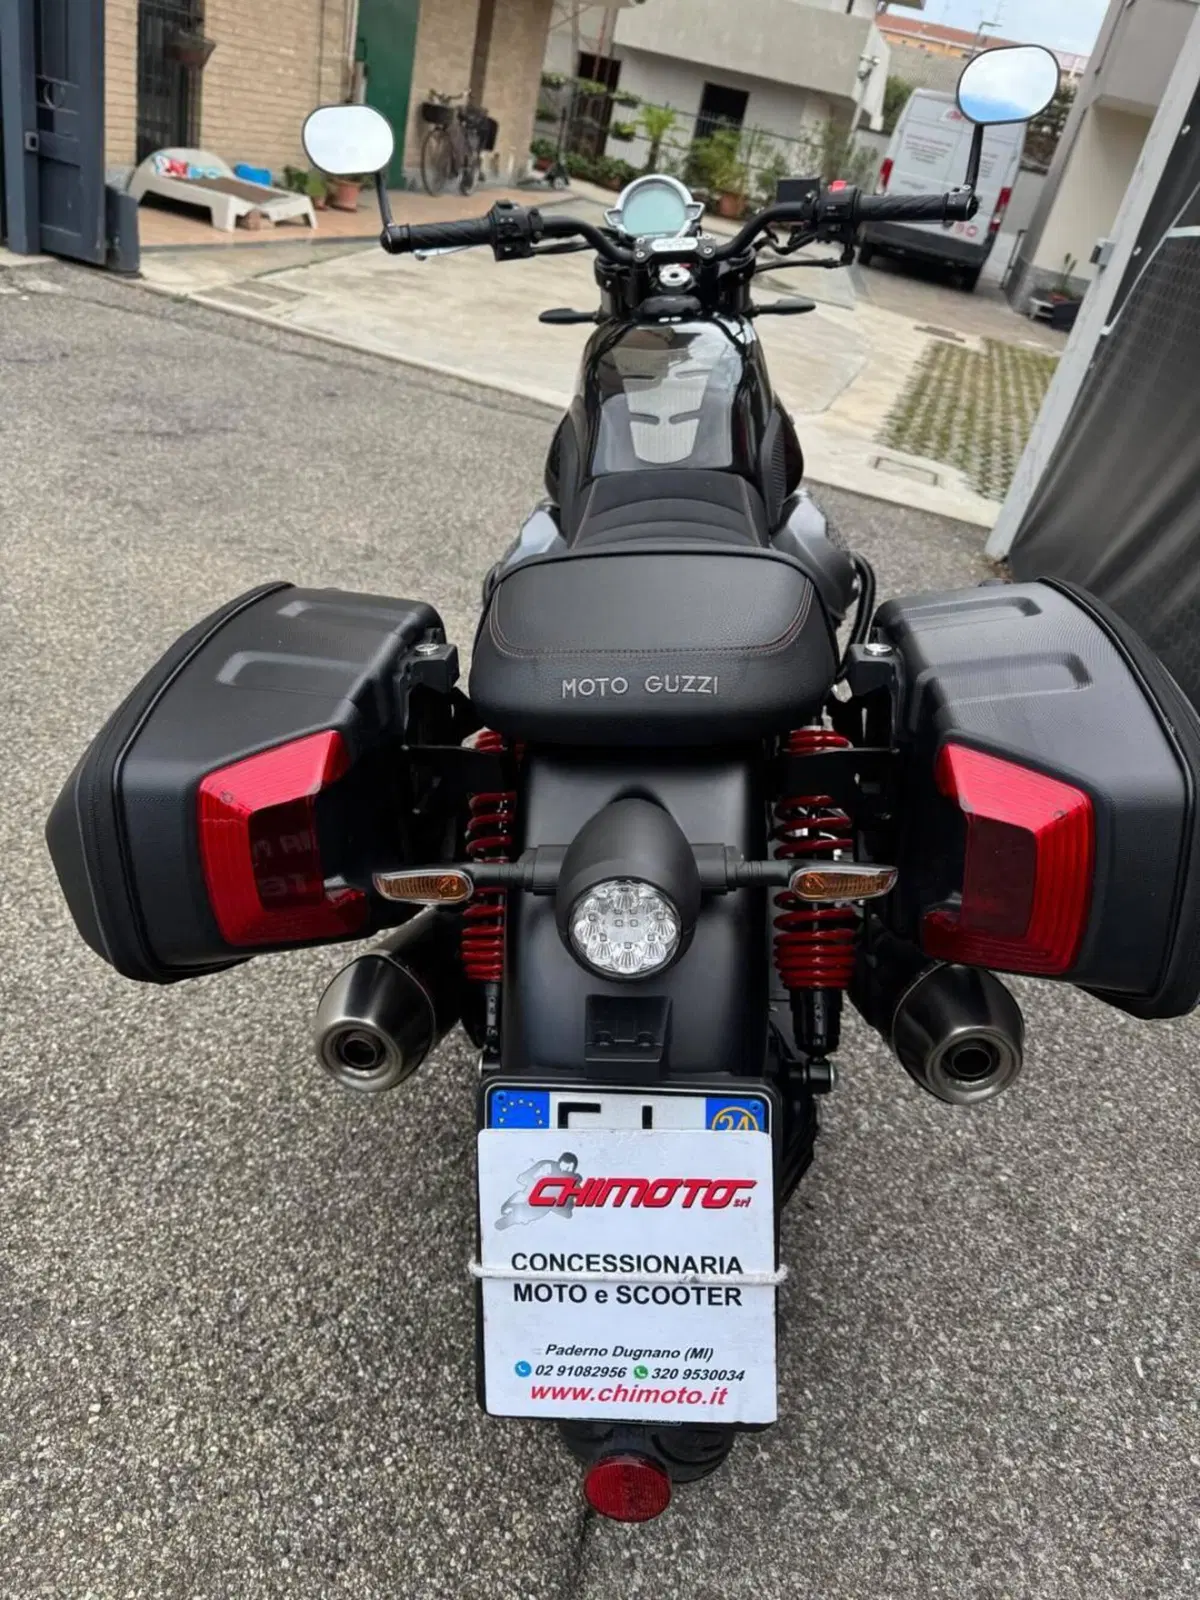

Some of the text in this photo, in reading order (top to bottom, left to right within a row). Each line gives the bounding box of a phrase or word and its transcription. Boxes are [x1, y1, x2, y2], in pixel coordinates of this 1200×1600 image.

[562, 674, 719, 698] MOTO GUZZI
[528, 1177, 757, 1209] CHIMOTO srl
[511, 1252, 744, 1275] CONCESSIONARIA
[513, 1283, 743, 1307] MOTO e SCOOTER
[545, 1343, 714, 1363] Paderno Dugnano (MI)
[535, 1364, 746, 1382] 02 91082956 320 9530034
[530, 1383, 728, 1406] www.chimoto.it
